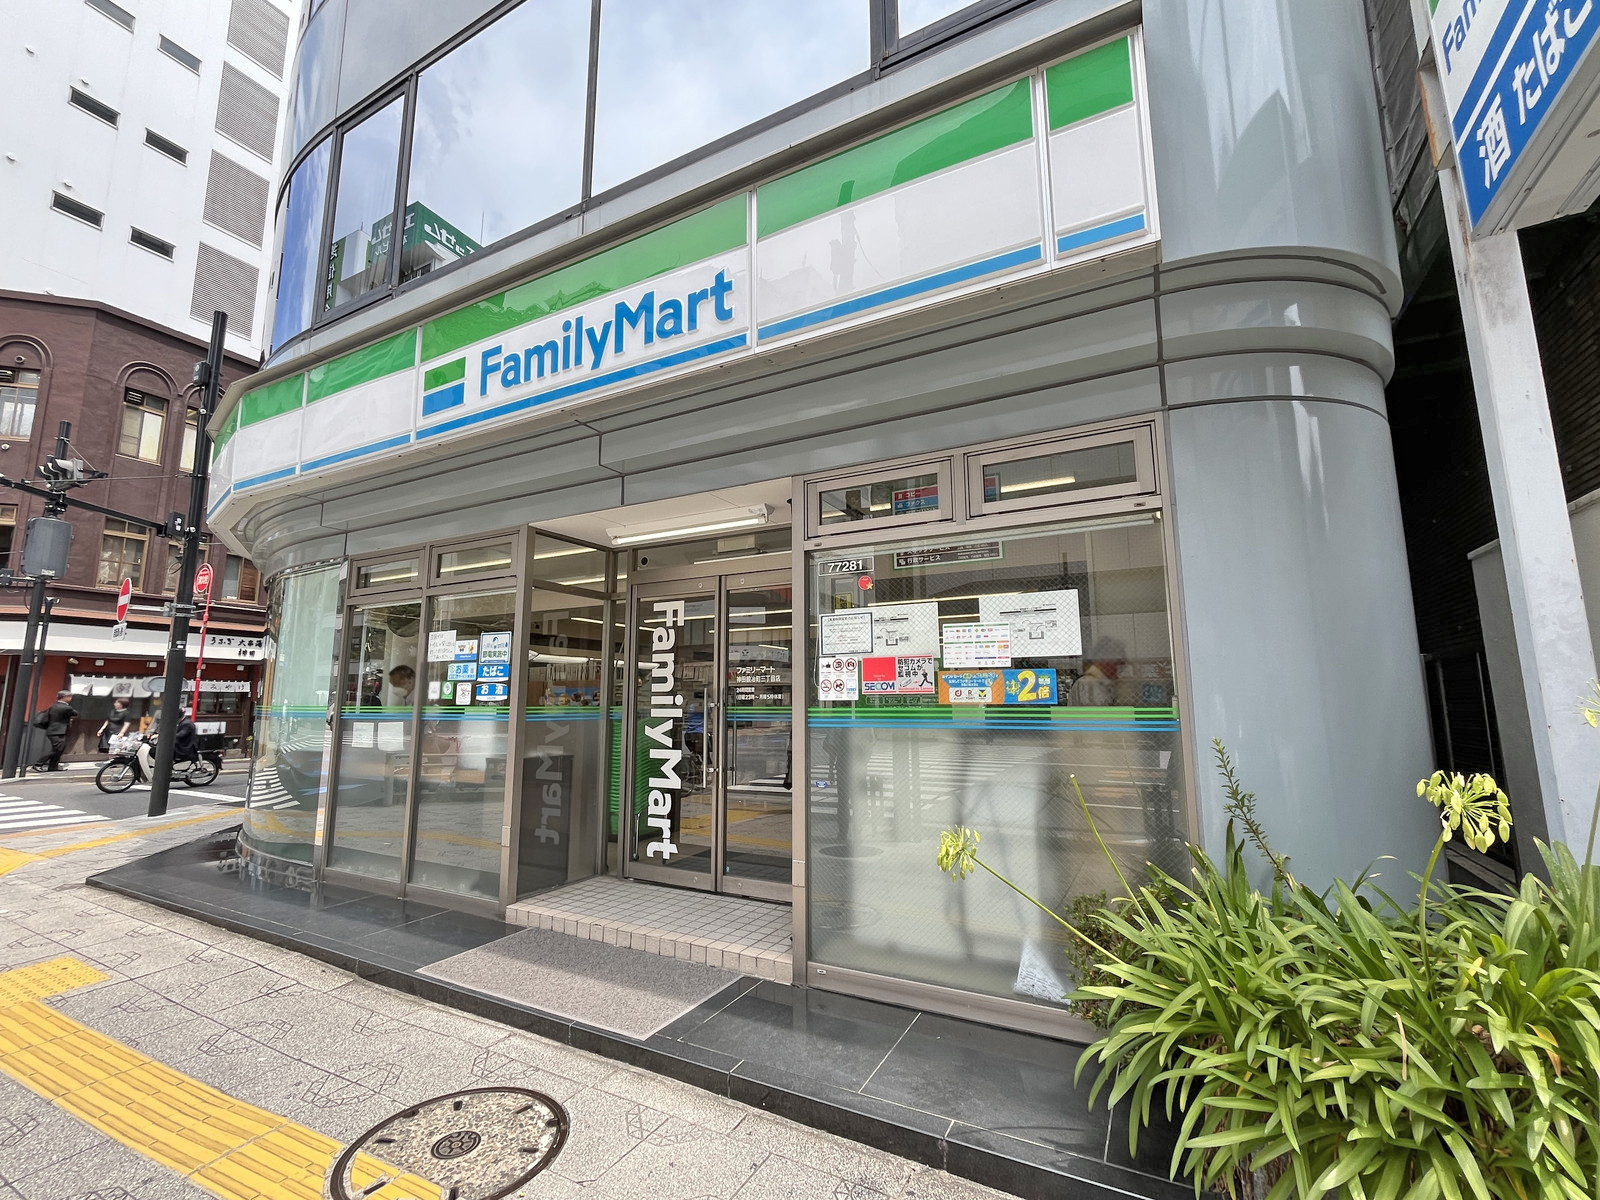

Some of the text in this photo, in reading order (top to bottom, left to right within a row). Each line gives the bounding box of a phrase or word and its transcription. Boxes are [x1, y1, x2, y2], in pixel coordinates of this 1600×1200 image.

[1477, 0, 1593, 189] 酒 たばこ
[479, 267, 734, 398] FamilyMart
[828, 559, 863, 573] 77281
[482, 665, 505, 677] たばこ
[736, 665, 776, 674] ファミリーマート
[480, 684, 504, 695] お酒
[864, 681, 896, 691] SECOM
[644, 600, 685, 860] FamilyMart
